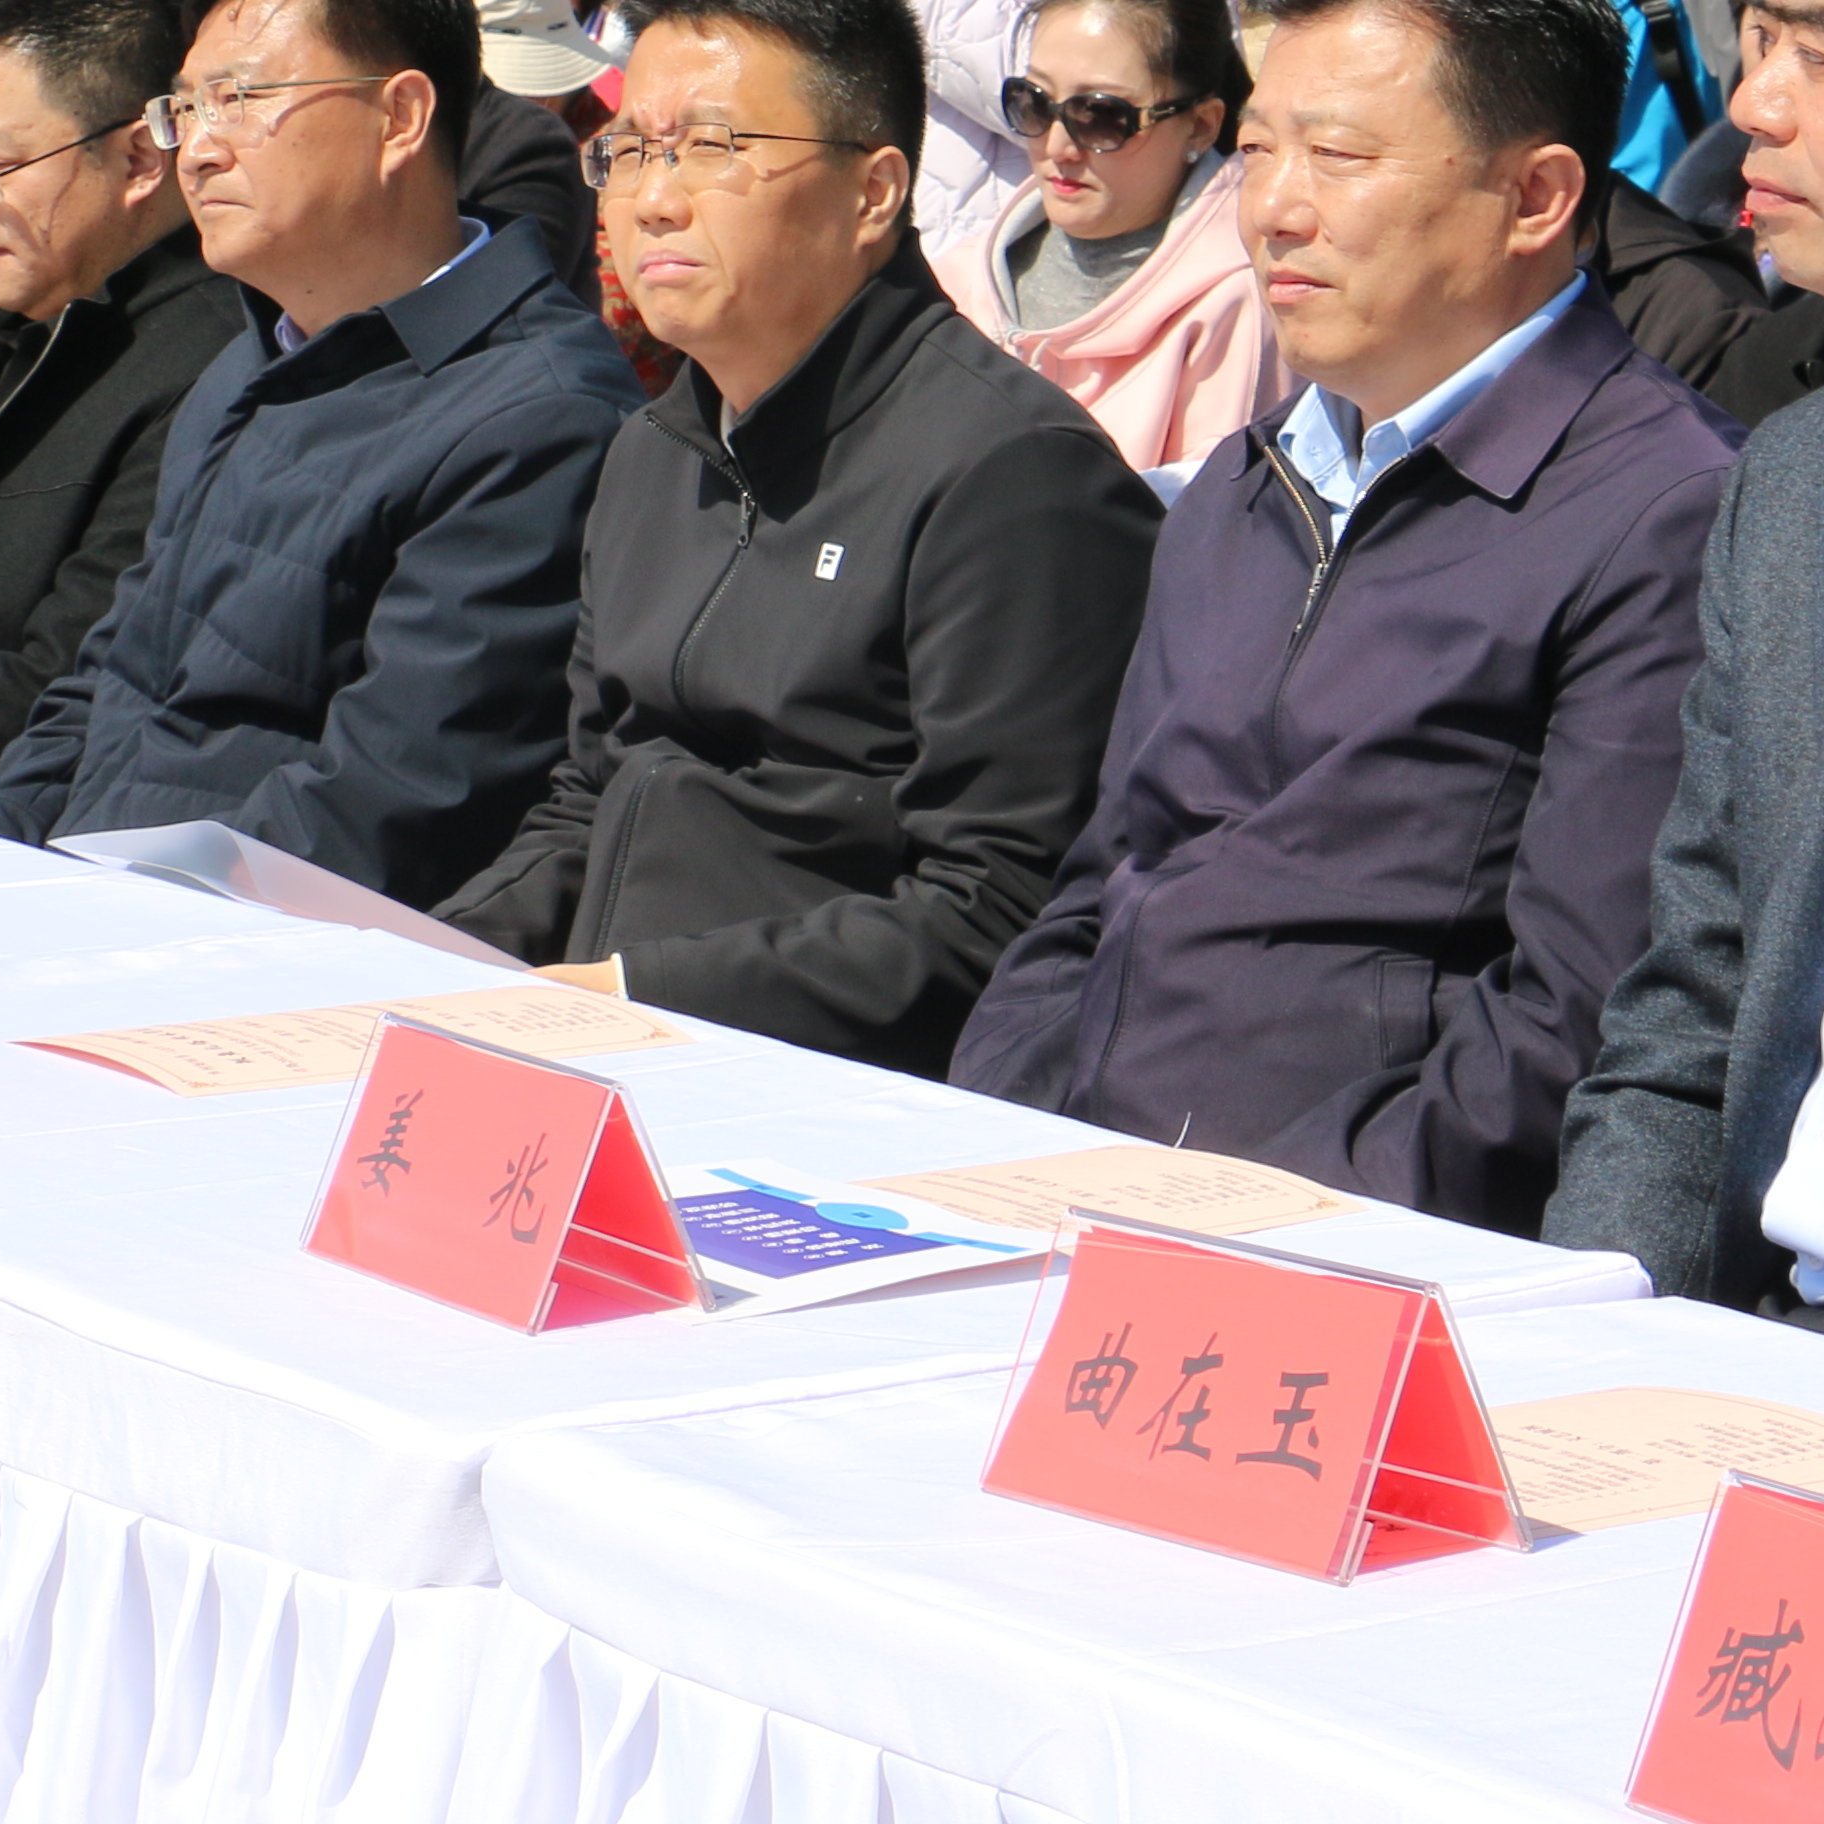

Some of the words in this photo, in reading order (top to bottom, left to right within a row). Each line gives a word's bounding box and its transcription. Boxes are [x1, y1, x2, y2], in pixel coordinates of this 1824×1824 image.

[356, 1088, 550, 1246] 姜兆
[1064, 1321, 1330, 1483] 曲在玉
